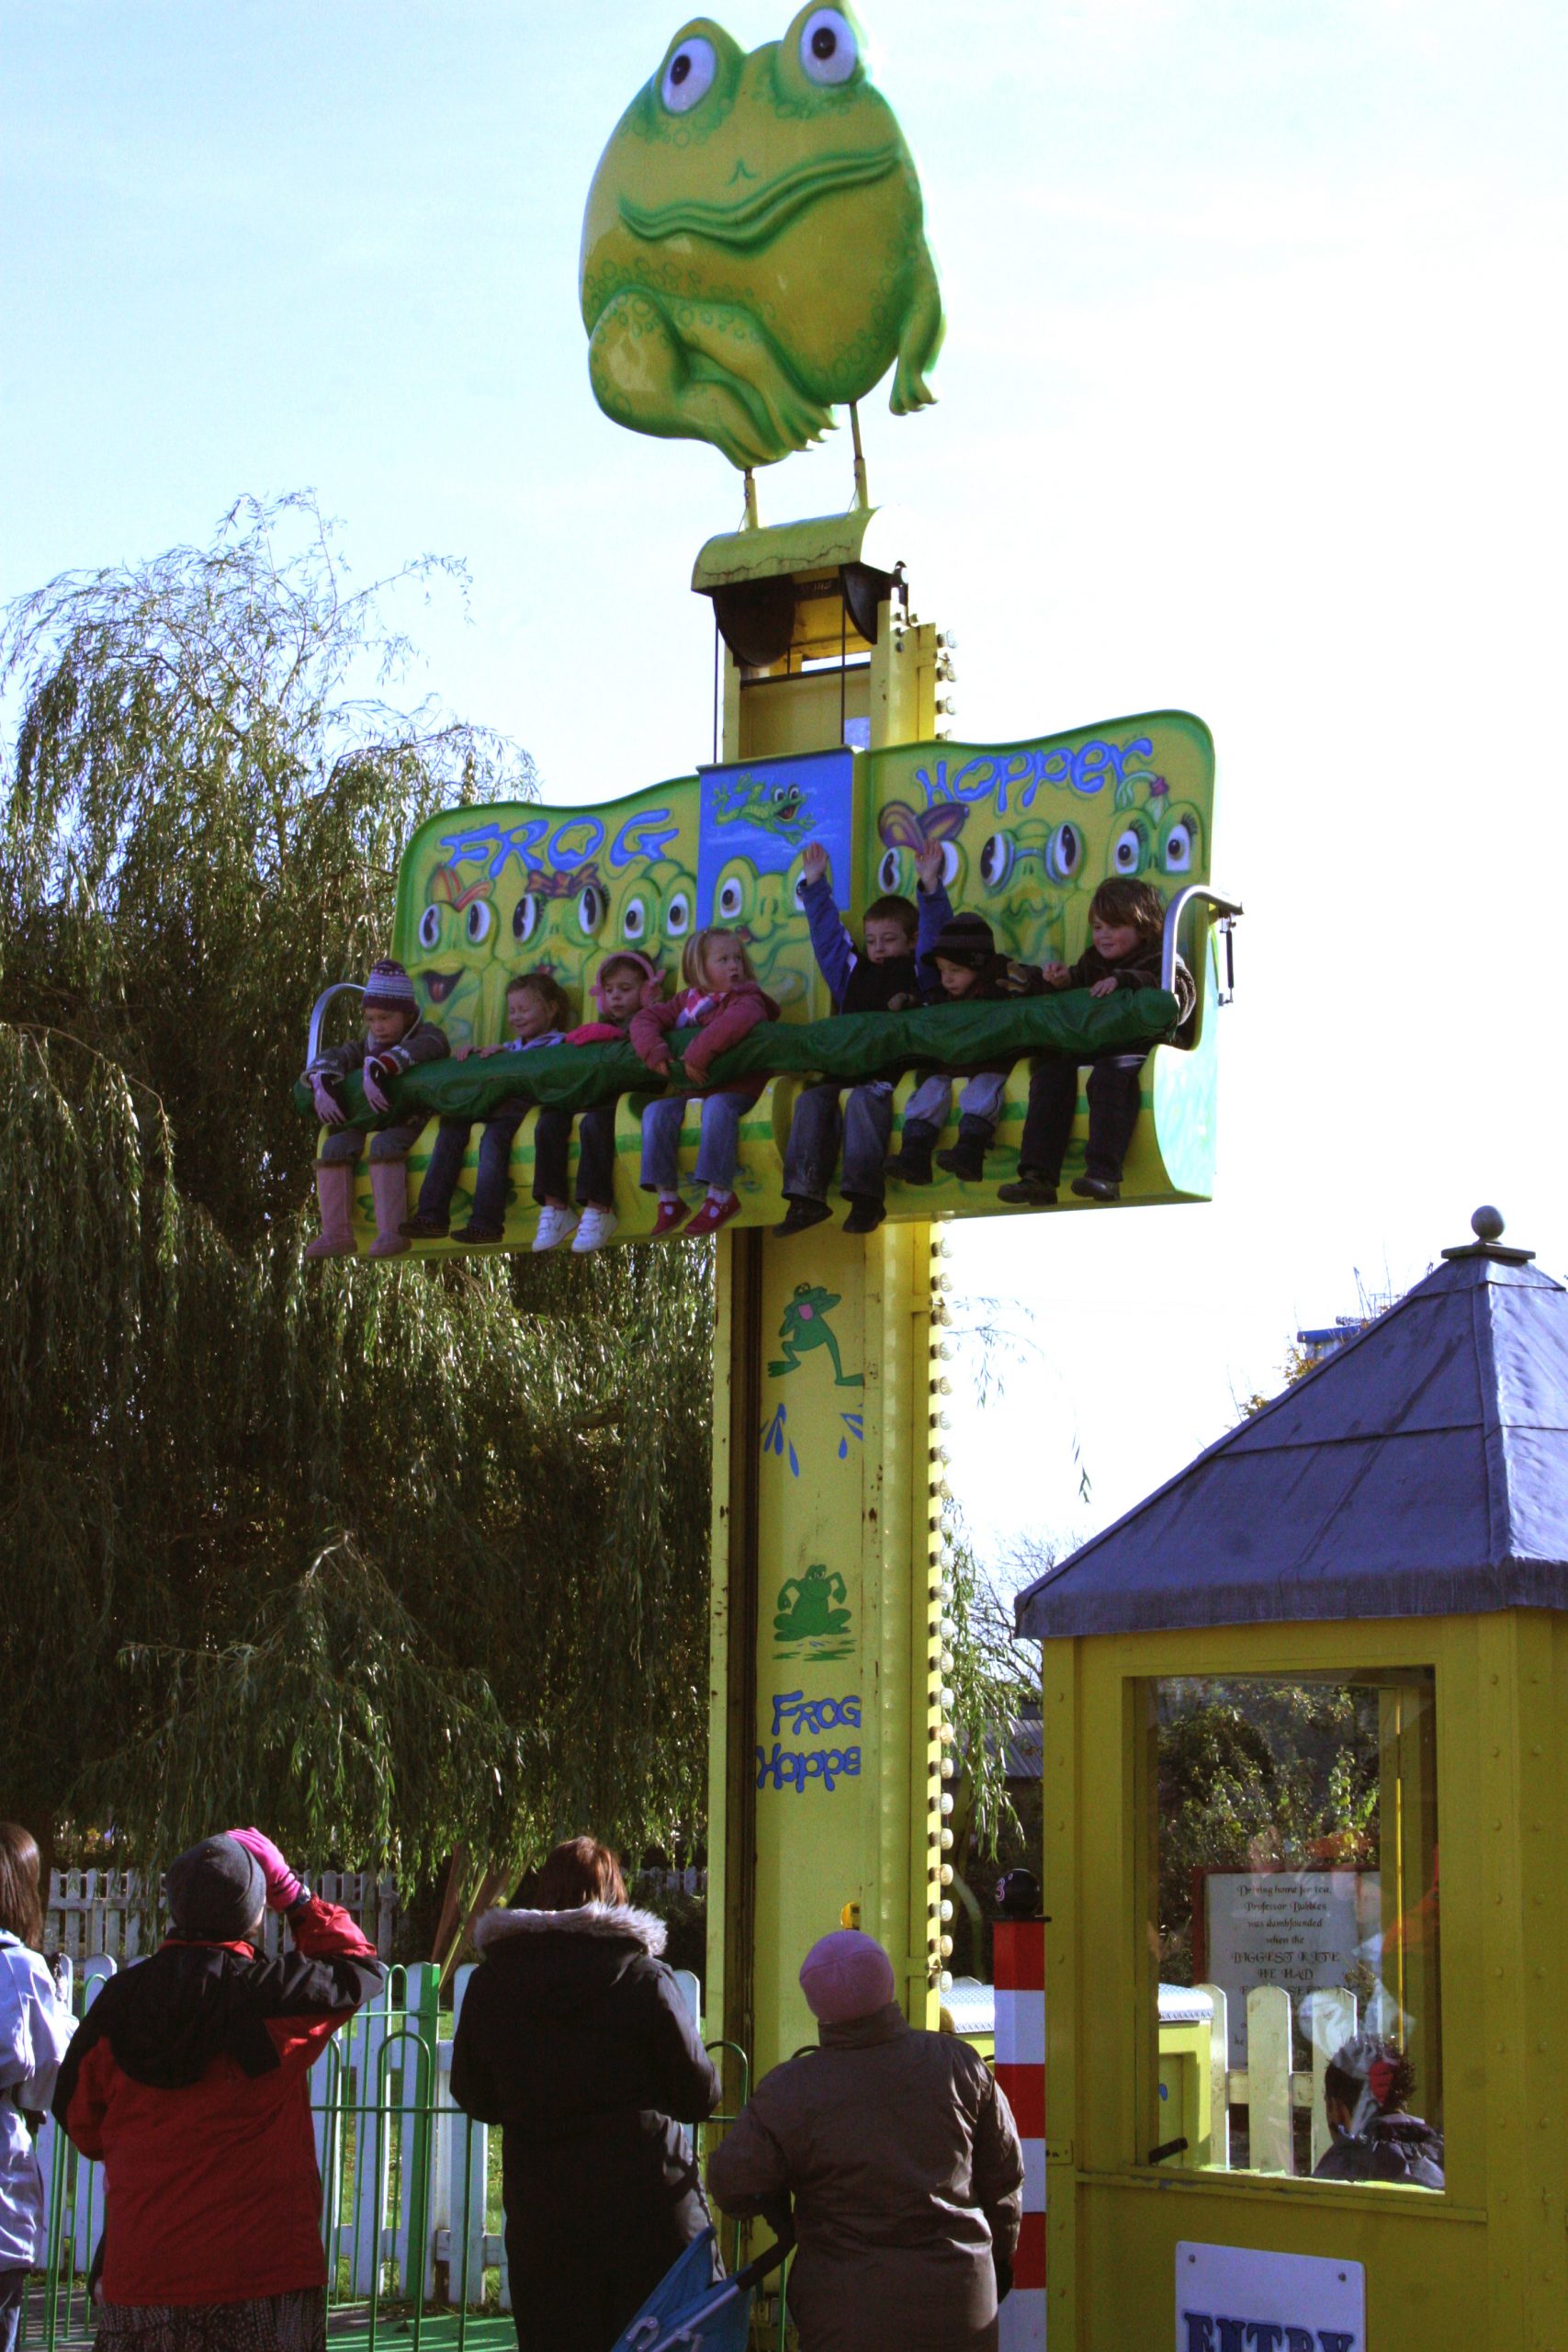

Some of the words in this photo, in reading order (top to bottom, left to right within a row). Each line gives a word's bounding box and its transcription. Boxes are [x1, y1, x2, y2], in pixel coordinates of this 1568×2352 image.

[439, 808, 681, 879] FROG
[772, 1690, 862, 1736] FROG
[1274, 1885, 1297, 1894] home
[1300, 1885, 1311, 1896] for
[1245, 1901, 1287, 1912] Professor
[1290, 1901, 1327, 1913] Bubbles
[1266, 1918, 1323, 1929] dumbfounded
[1266, 1935, 1289, 1944] when
[1292, 1935, 1305, 1944] the
[1232, 1951, 1294, 1964] BIGGEST
[1299, 1951, 1341, 1964] KITE
[1258, 1968, 1276, 1978] HE
[1281, 1968, 1314, 1980] HAD
